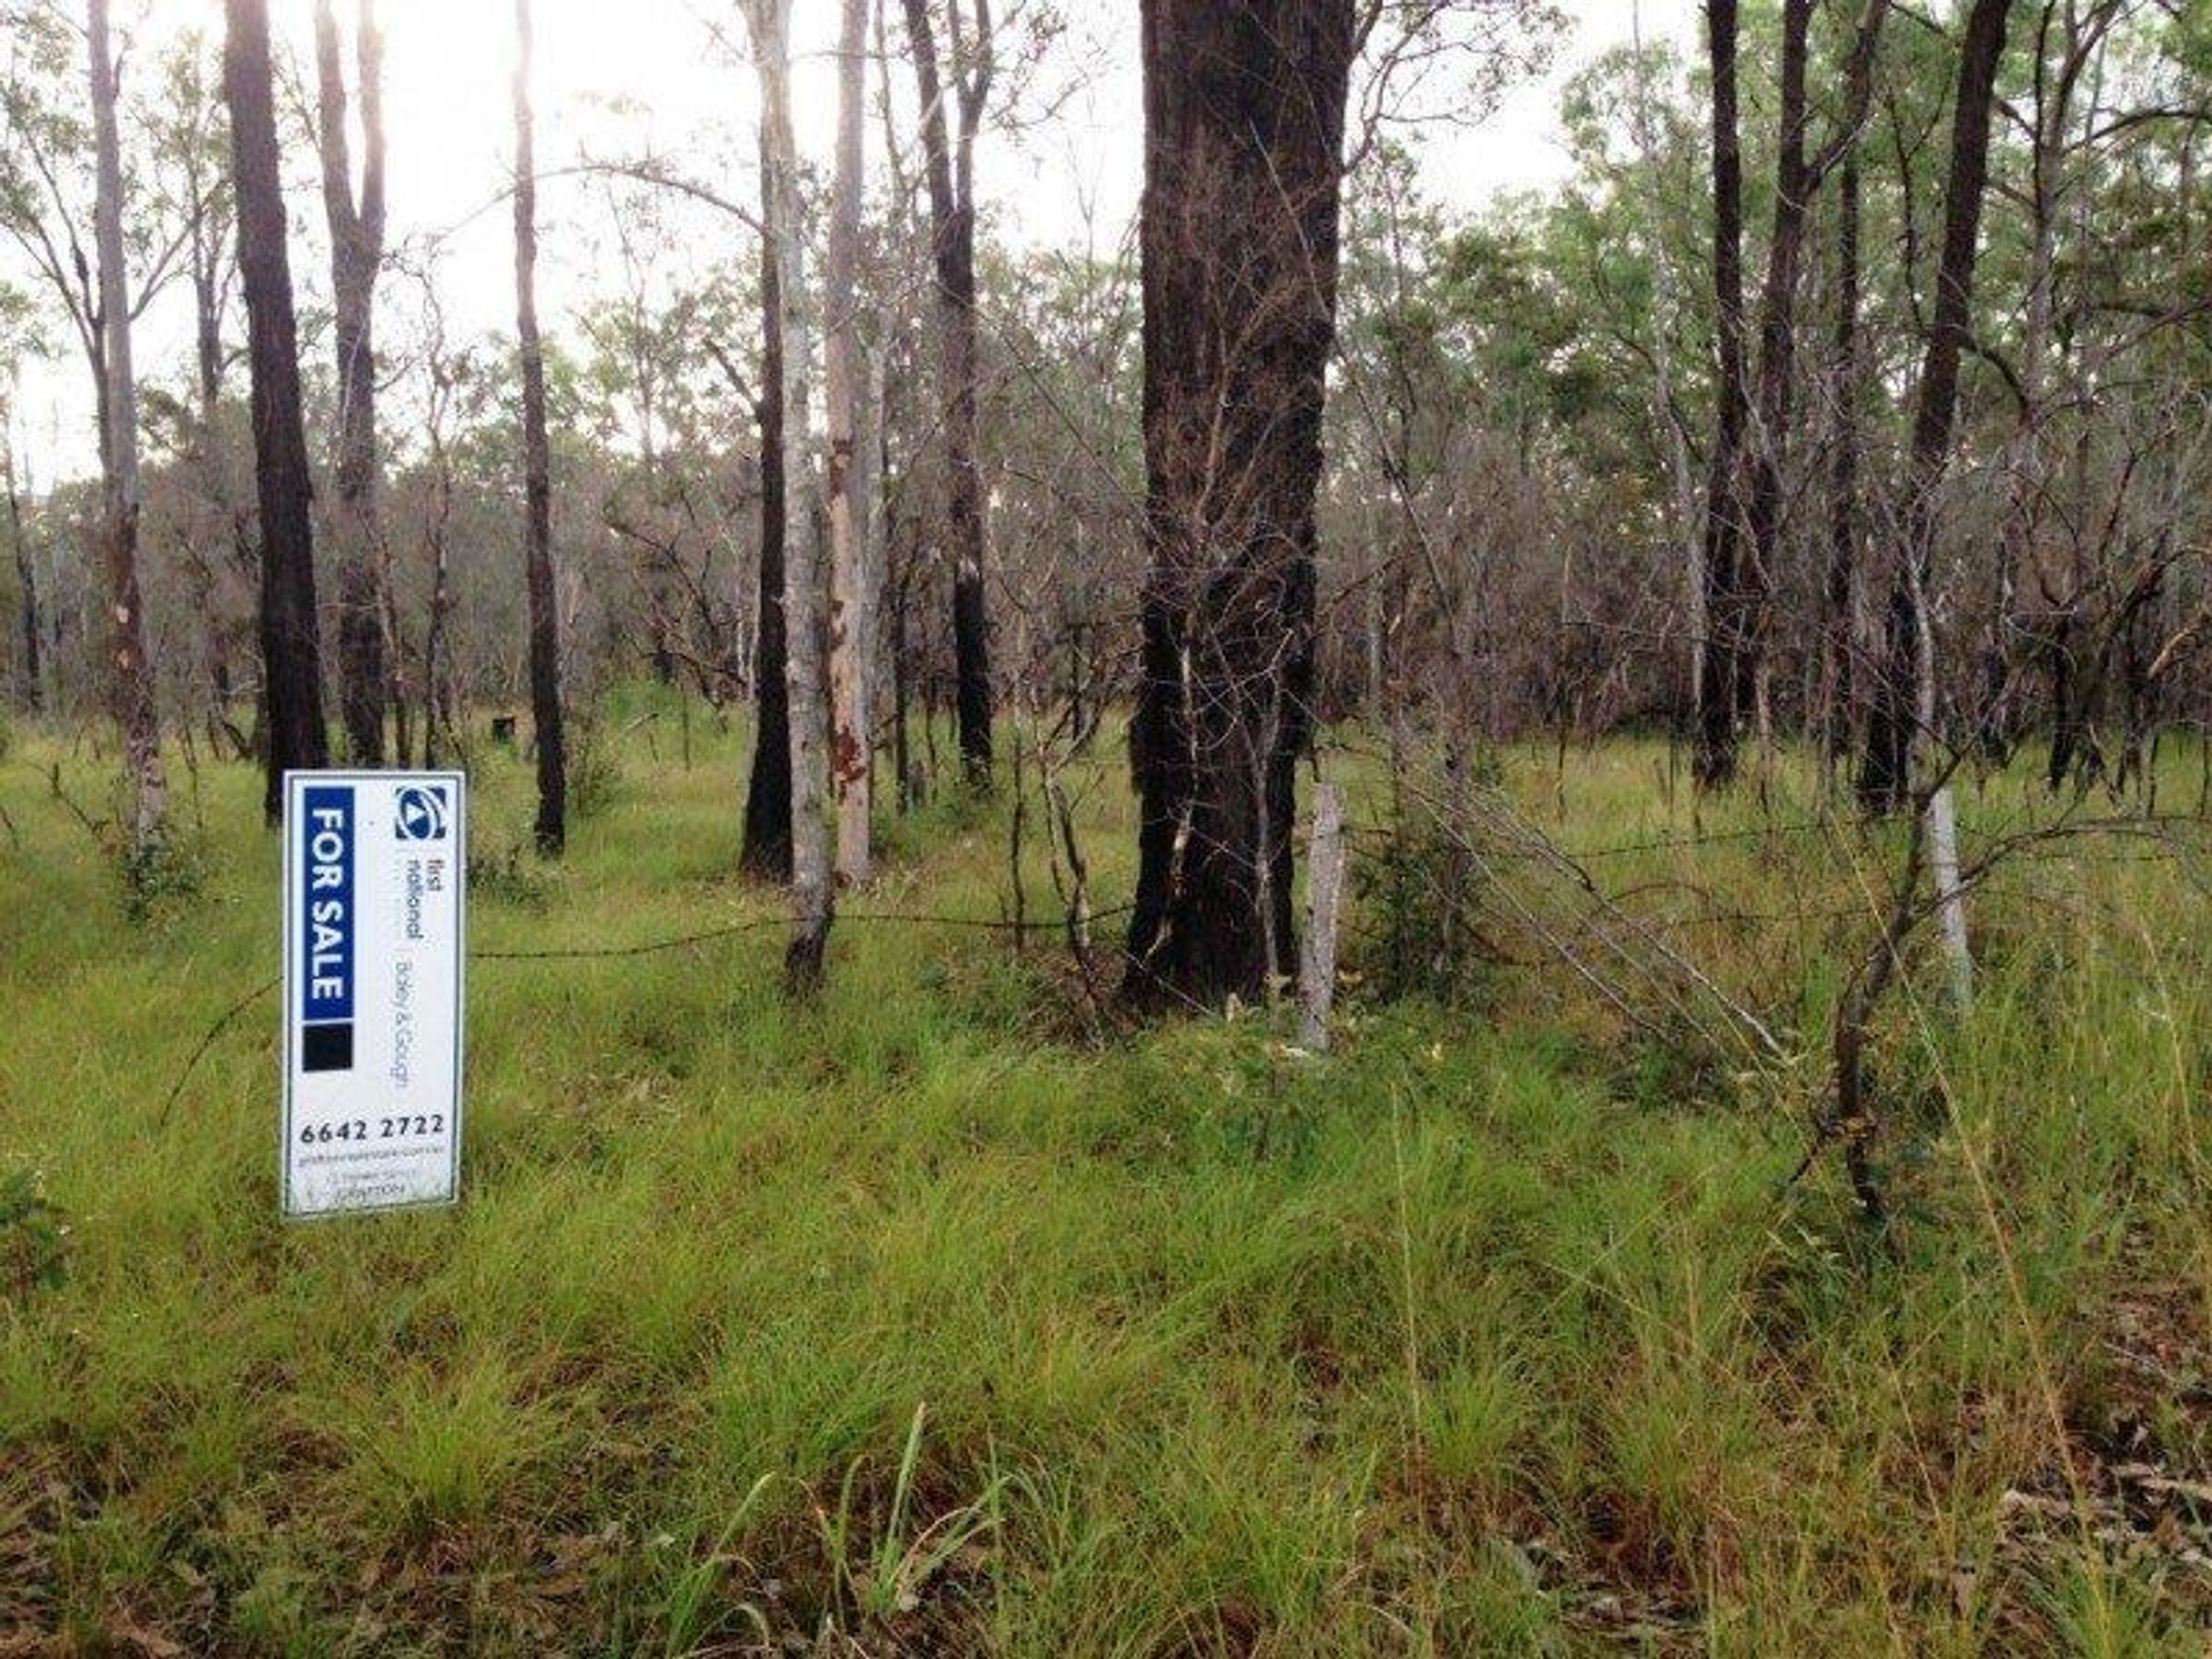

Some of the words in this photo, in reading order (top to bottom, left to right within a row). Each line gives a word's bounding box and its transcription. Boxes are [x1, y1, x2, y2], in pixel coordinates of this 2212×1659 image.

[312, 809, 343, 890] FOR
[426, 859, 445, 892] first
[406, 859, 424, 939] national
[312, 901, 343, 1000] SALE
[300, 1120, 367, 1144] 6642
[380, 1114, 445, 1138] 2722
